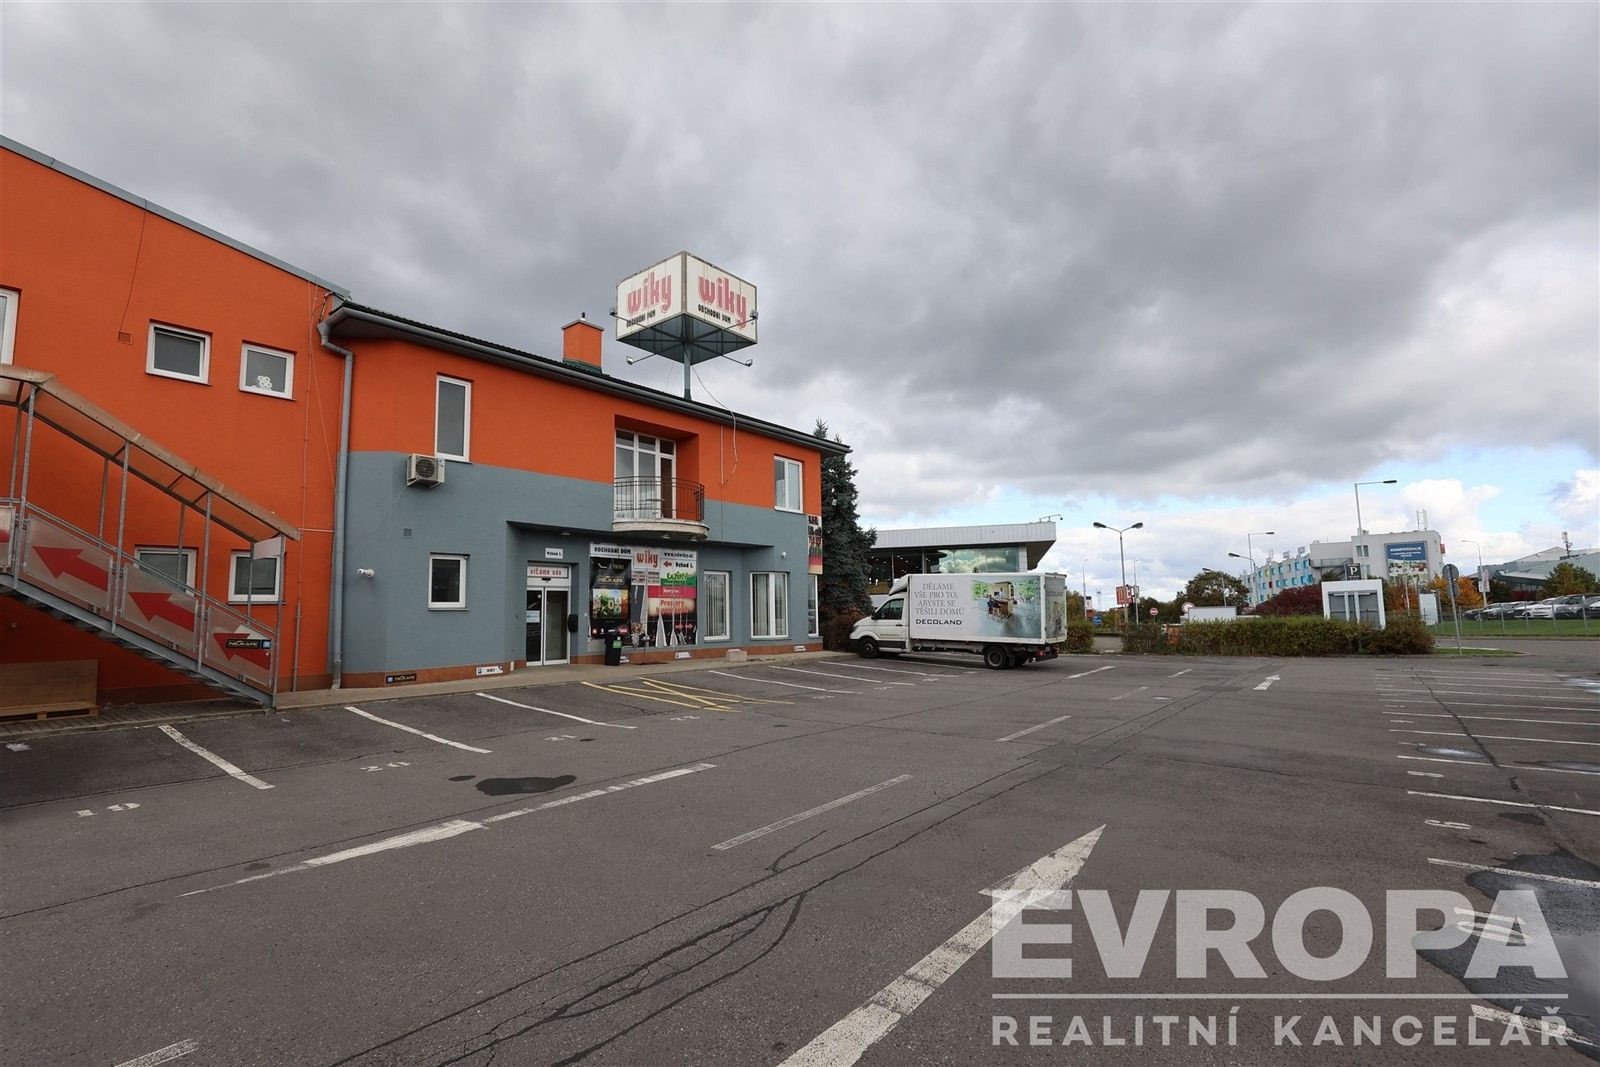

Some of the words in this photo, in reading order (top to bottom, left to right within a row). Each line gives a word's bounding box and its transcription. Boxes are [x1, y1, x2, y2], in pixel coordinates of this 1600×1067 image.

[626, 271, 672, 315] wiky
[698, 275, 747, 329] wiky
[636, 550, 659, 568] wiky
[1350, 566, 1358, 576] P
[915, 618, 963, 626] DECOLAND
